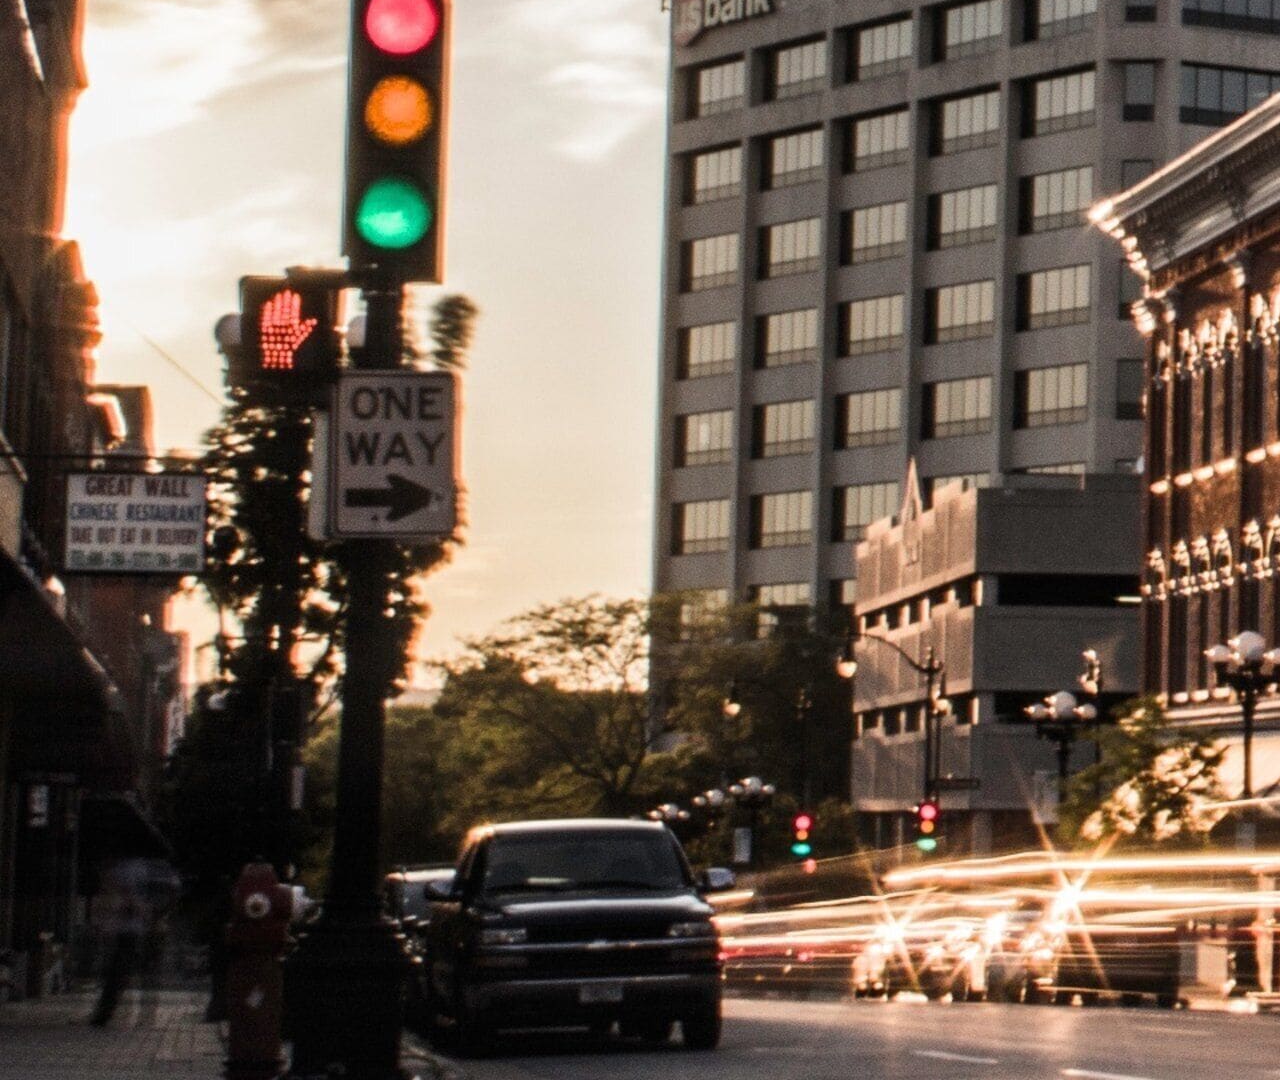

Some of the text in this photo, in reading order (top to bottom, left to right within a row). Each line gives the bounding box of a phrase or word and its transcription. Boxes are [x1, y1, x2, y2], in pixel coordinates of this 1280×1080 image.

[351, 386, 445, 420] ONE
[345, 431, 446, 466] WAY
[85, 476, 191, 498] GREAT WALL
[71, 503, 202, 522] CHINESE RESTAURANT
